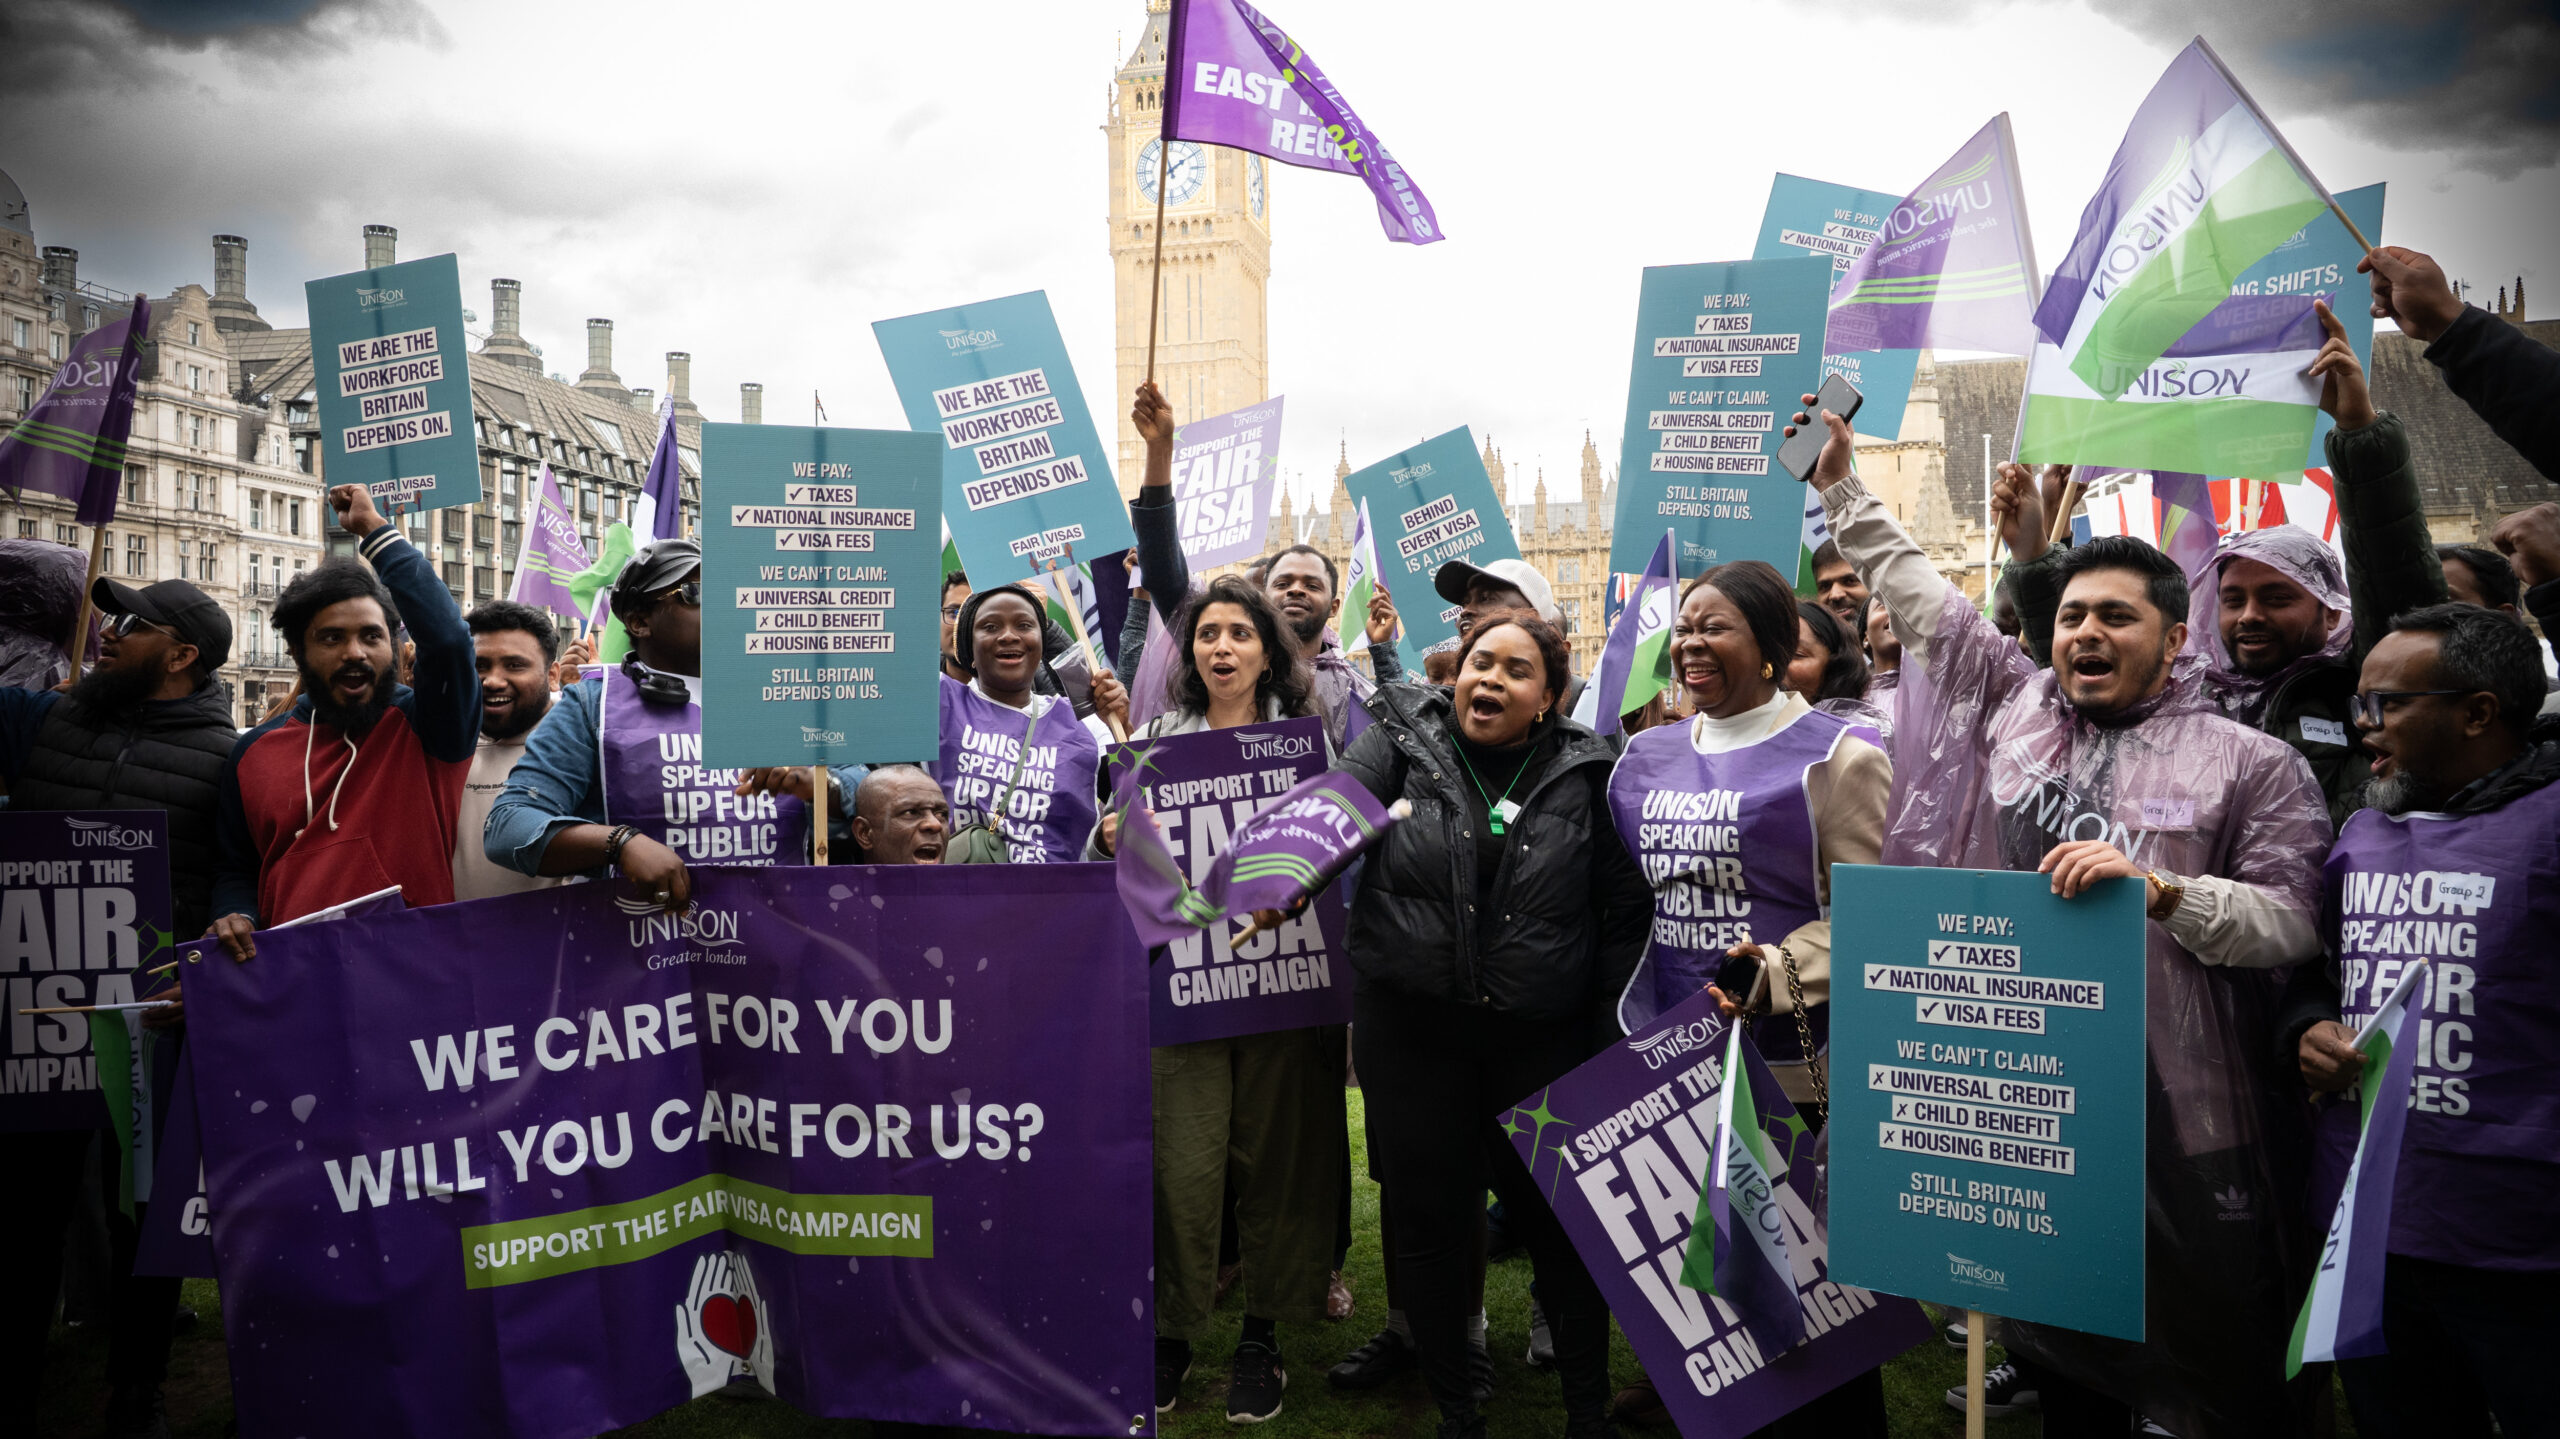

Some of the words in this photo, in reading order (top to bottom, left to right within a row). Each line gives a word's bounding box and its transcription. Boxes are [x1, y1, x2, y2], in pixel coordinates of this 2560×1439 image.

[1194, 62, 1291, 111] EAST
[1834, 208, 1854, 219] WE
[1855, 212, 1879, 226] PAY:
[1796, 234, 1850, 254] NATIONAL
[1841, 227, 1876, 242] TAXES
[2265, 264, 2344, 296] SHIFTS,
[360, 288, 403, 307] UNISON
[1703, 295, 1722, 309] WE
[1725, 294, 1750, 309] PAY:
[1713, 317, 1749, 331] TAXES
[343, 344, 367, 363] WE
[371, 338, 400, 359] ARE
[404, 332, 434, 352] THE
[947, 328, 997, 350] UNISON
[1669, 340, 1724, 354] NATIONAL
[1727, 338, 1796, 352] INSURANCE
[343, 359, 439, 392] WORKFORCE
[1701, 360, 1727, 373] VISA
[1730, 360, 1759, 373] FEES
[938, 390, 971, 413] WE
[974, 381, 1009, 406] ARE
[1009, 373, 1045, 397] THE
[2100, 367, 2251, 398] UNISON
[364, 391, 424, 417] BRITAIN
[1669, 391, 1687, 404] WE
[1689, 391, 1724, 405] CAN'T
[1727, 391, 1769, 405] CLAIM:
[947, 402, 1059, 444] WORKFORCE
[1233, 408, 1276, 428] UNISON
[1662, 414, 1725, 427] UNIVERSAL
[1727, 415, 1771, 428] CREDIT
[347, 421, 417, 449] DEPENDS
[422, 416, 448, 435] ON.
[1179, 434, 1238, 461] SUPPORT
[1241, 426, 1263, 443] THE
[1674, 436, 1707, 449] CHILD
[1711, 436, 1759, 450] BENEFIT
[979, 436, 1050, 470] BRITAIN
[1664, 456, 1713, 470] HOUSING
[1717, 458, 1765, 472] BENEFIT
[793, 462, 817, 478] WE
[821, 463, 852, 479] PAY:
[1394, 462, 1431, 484] UNISON
[372, 482, 395, 495] FAIR
[402, 478, 433, 489] VISAS
[808, 487, 853, 502] TAXES
[967, 469, 1050, 505] DEPENDS
[1052, 461, 1083, 483] ON.
[1666, 486, 1697, 499] STILL
[1700, 488, 1748, 502] BRITAIN
[391, 492, 411, 502] NOW
[753, 510, 826, 525] NATIONAL
[831, 511, 912, 527] INSURANCE
[1404, 498, 1454, 529] BEHIND
[1658, 502, 1710, 517] DEPENDS
[1714, 505, 1730, 518] ON
[1733, 506, 1753, 519] US.
[798, 533, 832, 547] VISA
[836, 534, 870, 548] FEES
[1012, 537, 1040, 554] FAIR
[1045, 527, 1082, 543] VISAS
[1400, 527, 1442, 555] EVERY
[1443, 514, 1477, 538] VISA
[1037, 545, 1060, 559] NOW
[1405, 560, 1421, 574] IS
[1422, 554, 1434, 569] A
[1435, 531, 1486, 562] HUMAN
[1684, 547, 1717, 559] UNISON
[760, 566, 784, 581] WE
[788, 567, 833, 581] CAN'T
[837, 567, 887, 582] CLAIM:
[755, 591, 835, 605] UNIVERSAL
[841, 591, 891, 605] CREDIT
[1442, 606, 1463, 621] FAIR
[772, 669, 812, 683] STILL
[817, 668, 874, 683] BRITAIN
[763, 686, 831, 701] DEPENDS
[836, 686, 855, 700] ON
[860, 686, 882, 699] US.
[803, 730, 844, 742] UNISON
[2303, 723, 2330, 735] Group
[1241, 736, 1312, 760] UNISON
[954, 776, 990, 806] UP
[990, 784, 1051, 821] FOR
[1158, 773, 1253, 808] SUPPORT
[1259, 767, 1299, 794] THE
[663, 790, 711, 824] UP
[715, 789, 778, 822] FOR
[1642, 789, 1744, 821] UNISON
[73, 828, 153, 848] UNISON
[666, 823, 777, 859] PUBLIC
[1639, 824, 1739, 852] SPEAKING
[91, 859, 134, 883] THE
[1641, 854, 1672, 889] UP
[1672, 855, 1746, 890] FOR
[1654, 880, 1751, 918] PUBLIC
[2439, 881, 2472, 898] Group
[630, 909, 738, 948] UNISON
[1654, 919, 1752, 950] SERVICES
[1938, 913, 1967, 933] WE
[1973, 916, 2014, 936] PAY:
[2341, 920, 2477, 958] SPEAKING
[647, 950, 702, 971] Greater
[705, 948, 747, 965] london
[1956, 947, 2016, 968] TAXES
[1169, 954, 1331, 1007] CAMPAIGN
[1890, 970, 1980, 995] NATIONAL
[1986, 978, 2099, 1005] INSURANCE
[1944, 1003, 1988, 1024] VISA
[1994, 1008, 2040, 1029] FEES
[410, 1024, 519, 1092] WE
[534, 992, 697, 1072] CARE
[706, 992, 801, 1054] FOR
[815, 998, 952, 1054] YOU
[1643, 1011, 1723, 1070] UNISON
[1897, 1040, 1926, 1061] WE
[1932, 1044, 1989, 1067] CAN'T
[1995, 1051, 2064, 1076] CLAIM:
[1891, 1071, 1993, 1101] UNIVERSAL
[1999, 1083, 2070, 1109] CREDIT
[1575, 1082, 1681, 1164] SUPPORT
[1676, 1054, 1725, 1099] THE
[324, 1137, 486, 1213] WILL
[498, 1112, 633, 1183] YOU
[651, 1090, 779, 1154] CARE
[790, 1103, 913, 1159] FOR
[930, 1102, 1044, 1162] US?
[1911, 1172, 1962, 1198] STILL
[1968, 1181, 2046, 1210] BRITAIN
[1900, 1193, 1987, 1224] DEPENDS
[1993, 1207, 2020, 1230] ON
[2026, 1214, 2059, 1236] US.
[473, 1224, 606, 1270] SUPPORT
[612, 1209, 668, 1247] THE
[673, 1189, 728, 1228] FAIR
[730, 1195, 772, 1229] VISA
[775, 1211, 921, 1239] CAMPAIGN
[1951, 1263, 2004, 1282] UNISON
